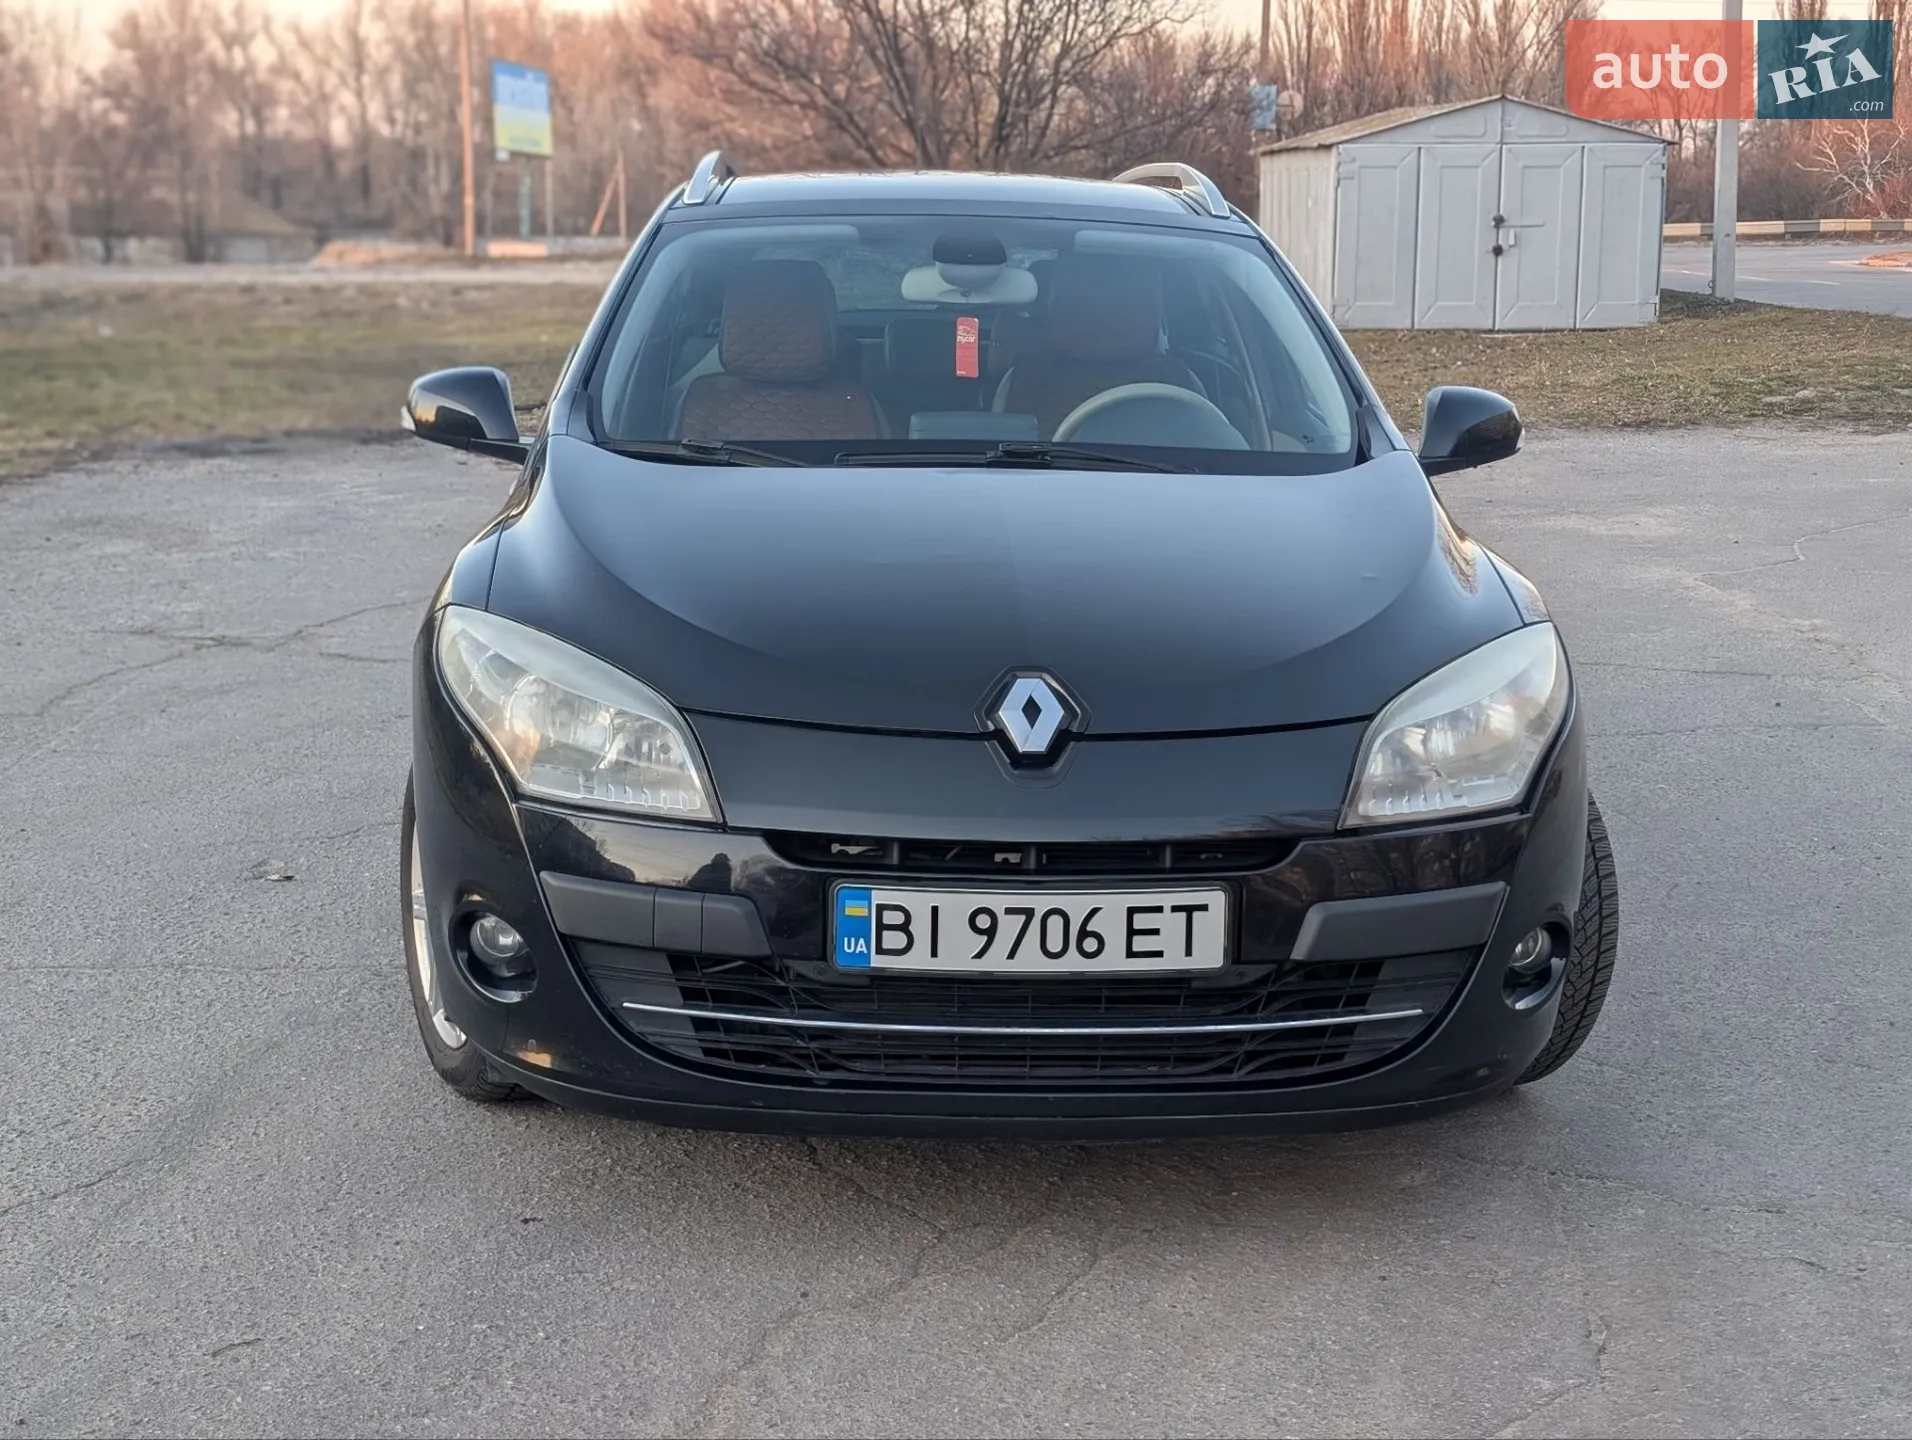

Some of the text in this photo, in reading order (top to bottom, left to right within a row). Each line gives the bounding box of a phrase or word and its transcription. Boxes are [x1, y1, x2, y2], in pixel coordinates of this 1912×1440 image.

[843, 937, 868, 955] UA
[874, 902, 1209, 960] BI 9706 ET
